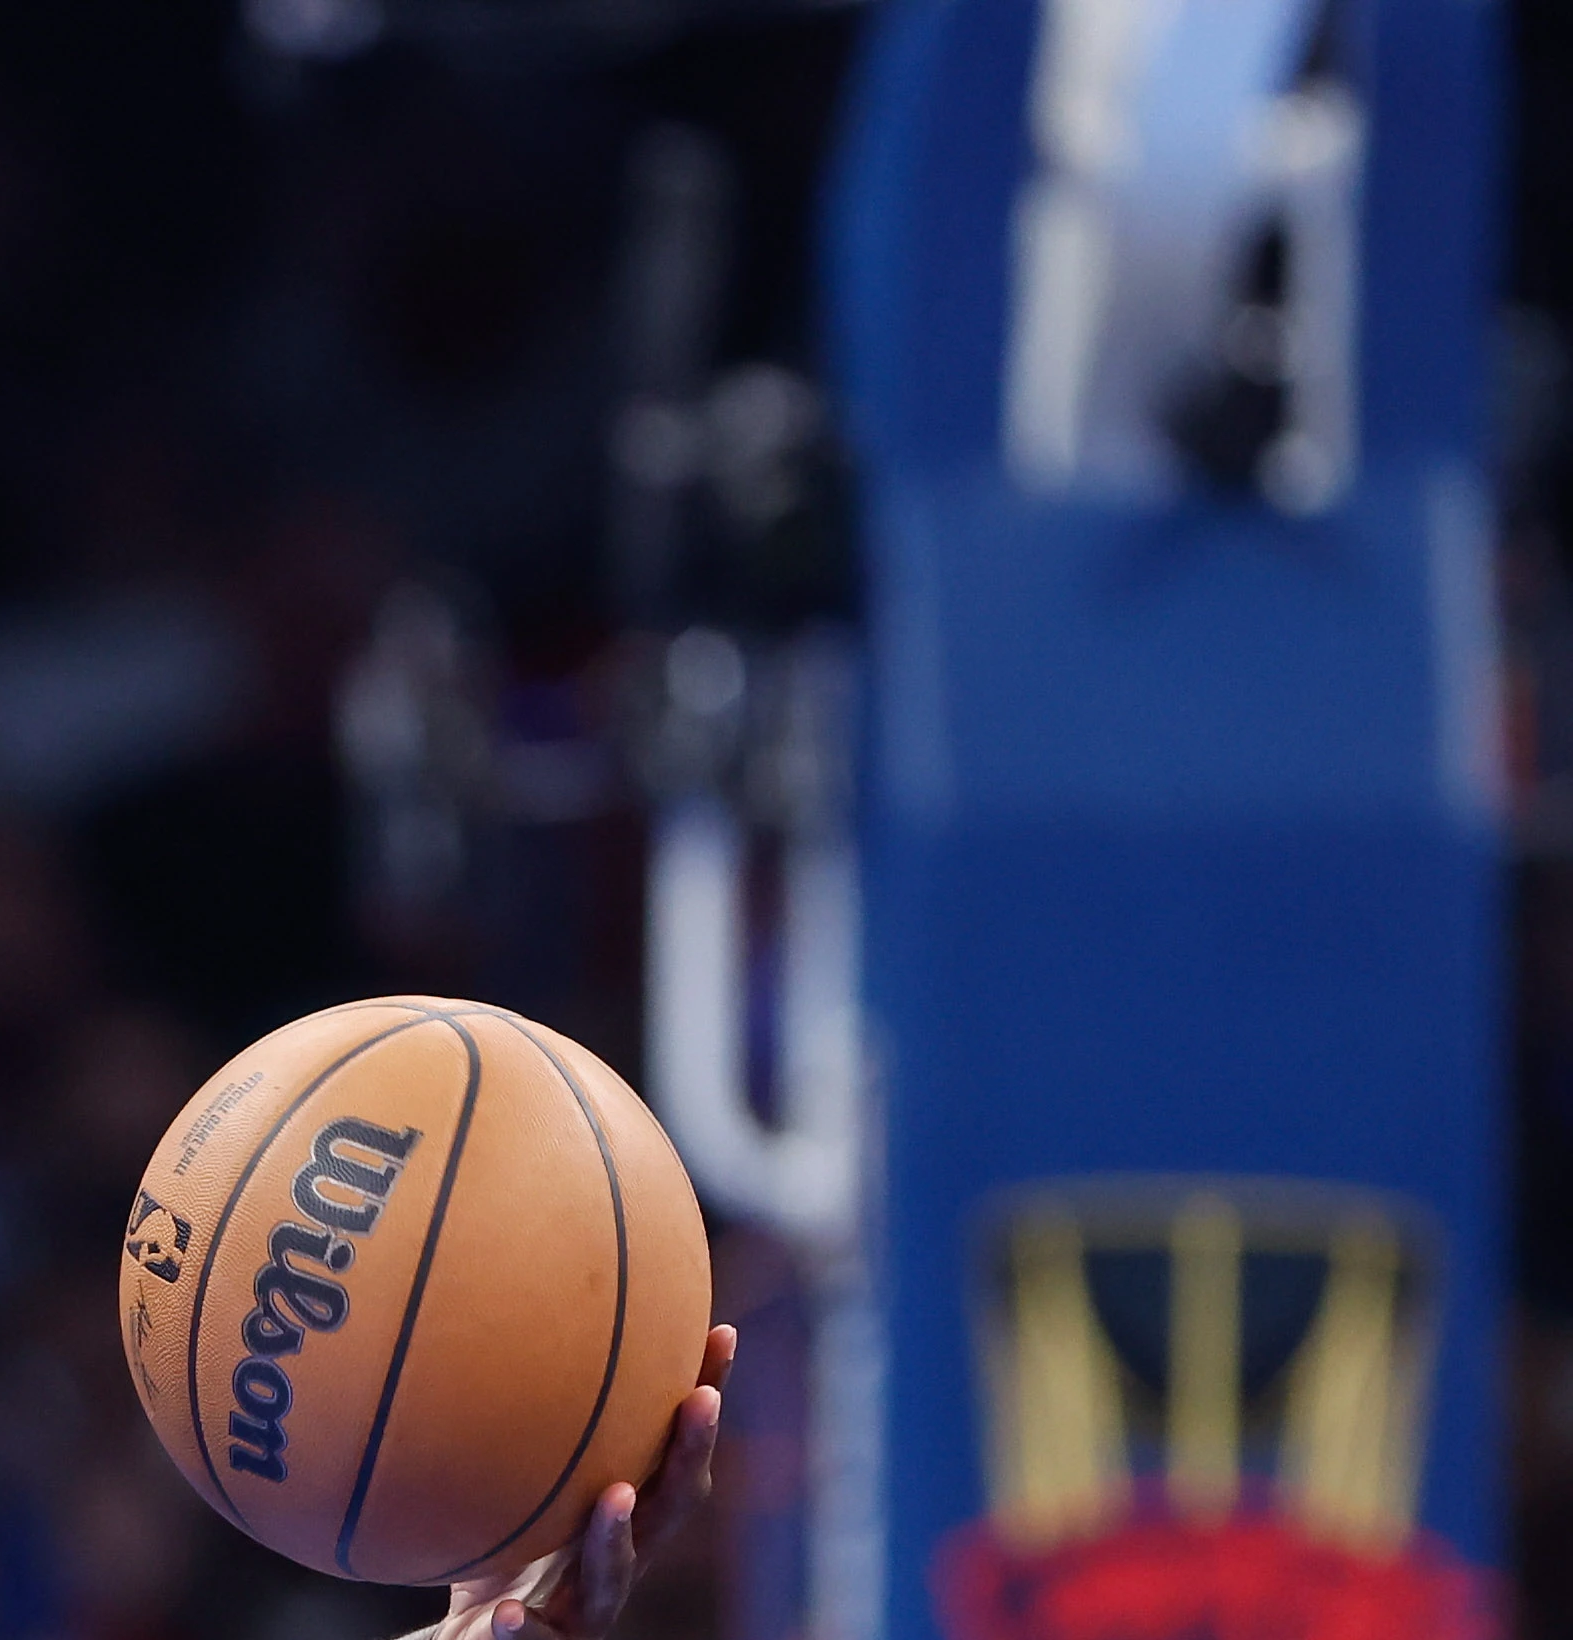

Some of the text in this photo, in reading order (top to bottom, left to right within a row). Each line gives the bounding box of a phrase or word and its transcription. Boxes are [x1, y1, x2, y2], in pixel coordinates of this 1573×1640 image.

[192, 1114, 221, 1147] GAME
[174, 1146, 198, 1176] BALL
[229, 1115, 424, 1483] Wilson
